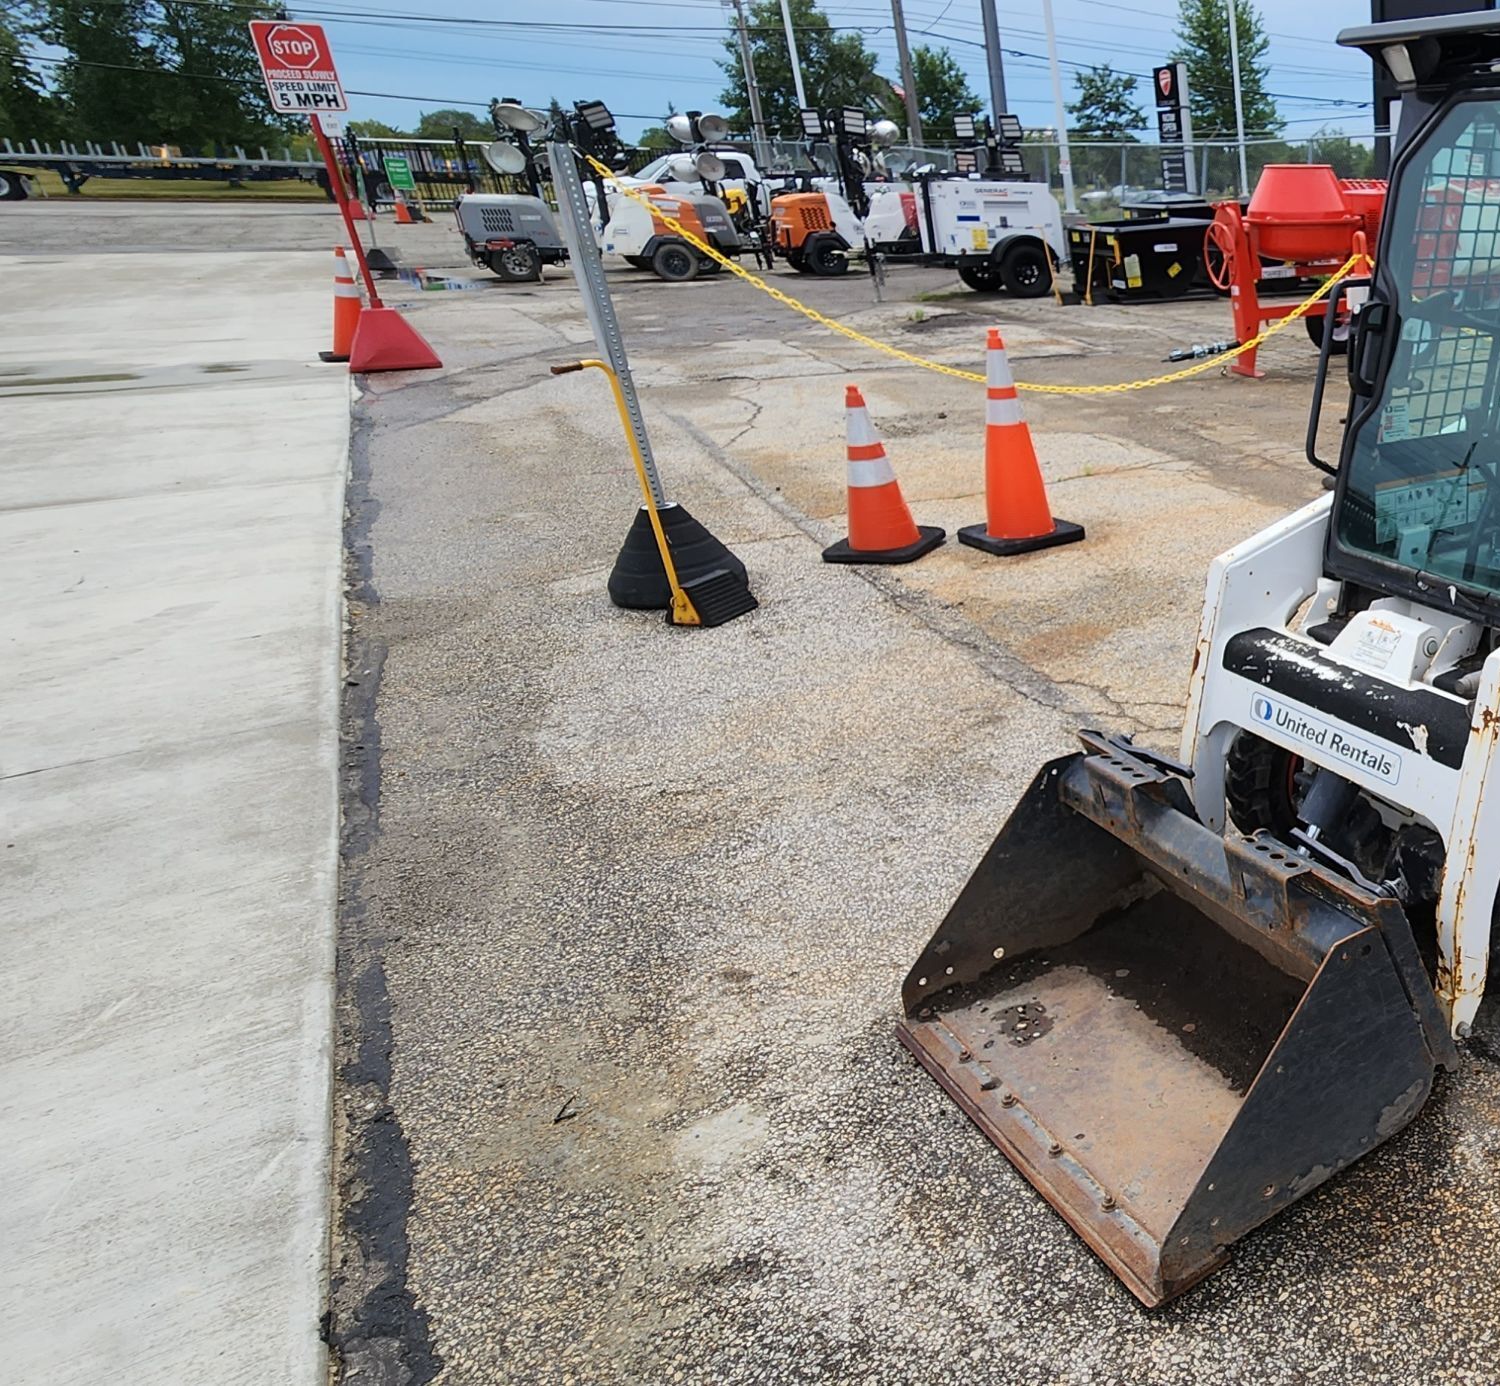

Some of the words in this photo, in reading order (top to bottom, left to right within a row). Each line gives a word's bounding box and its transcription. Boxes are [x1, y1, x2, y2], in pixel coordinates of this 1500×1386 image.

[272, 40, 312, 55] STOP
[266, 69, 302, 79] PROCEED
[302, 70, 335, 80] SLOWLY
[272, 82, 304, 92] SPEED
[307, 83, 337, 93] LIMIT
[280, 93, 291, 107] 5
[295, 93, 340, 107] MPH
[1275, 707, 1328, 746] United
[1329, 733, 1392, 776] Rentals
